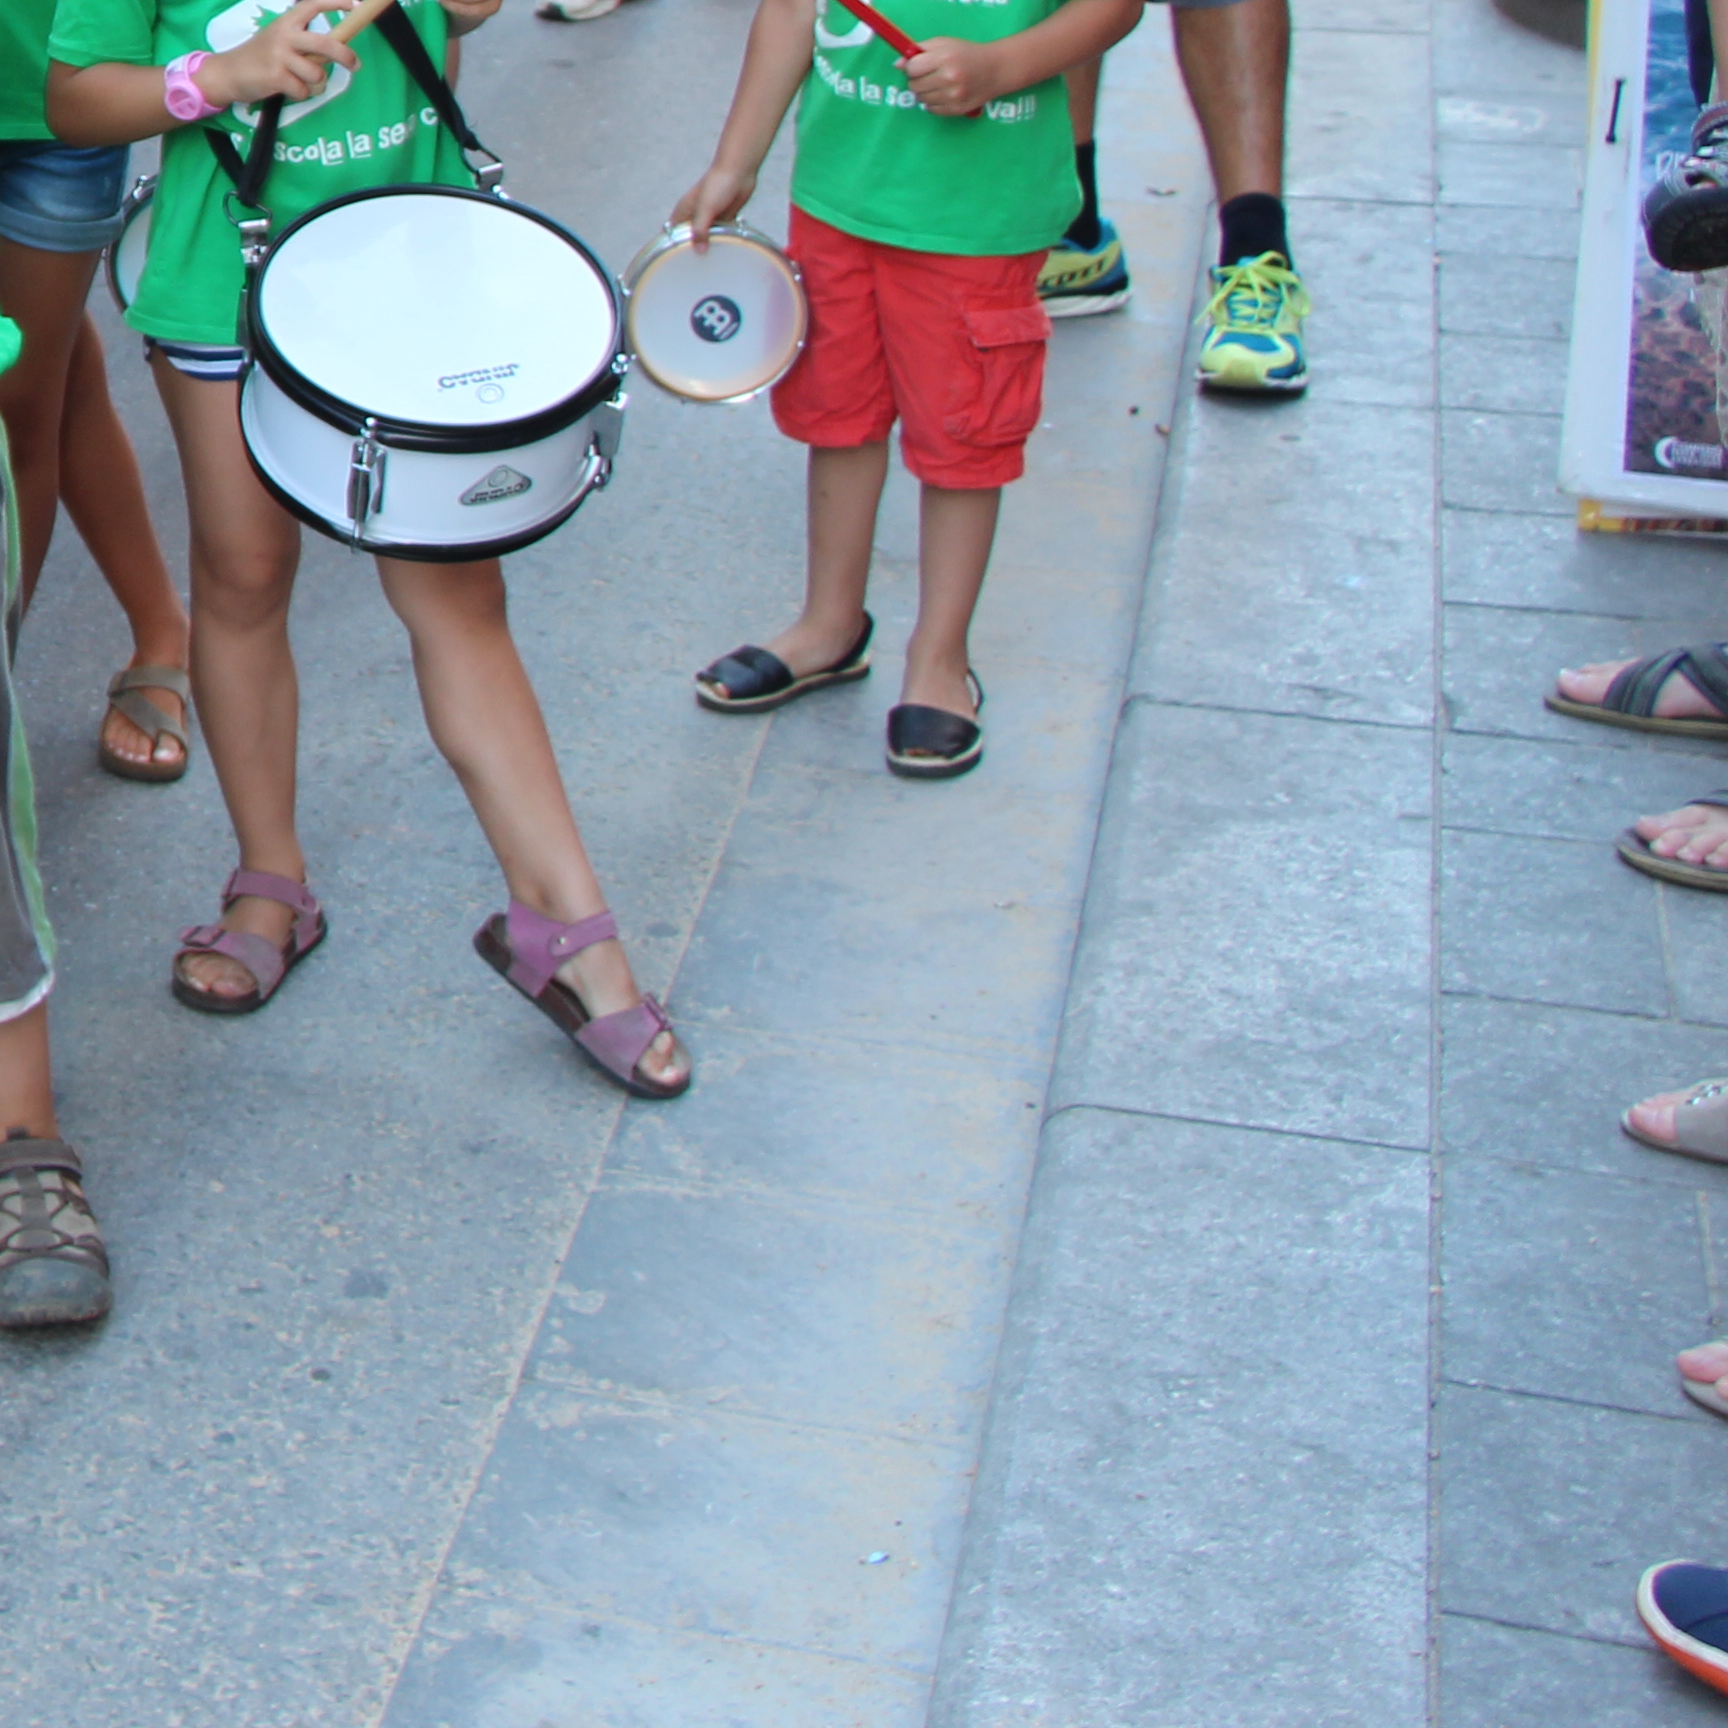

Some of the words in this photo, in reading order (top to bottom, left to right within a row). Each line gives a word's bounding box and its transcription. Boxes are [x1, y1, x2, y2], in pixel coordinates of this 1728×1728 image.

[859, 75, 883, 106] la
[346, 131, 373, 160] la
[438, 362, 521, 390] JINDAO
